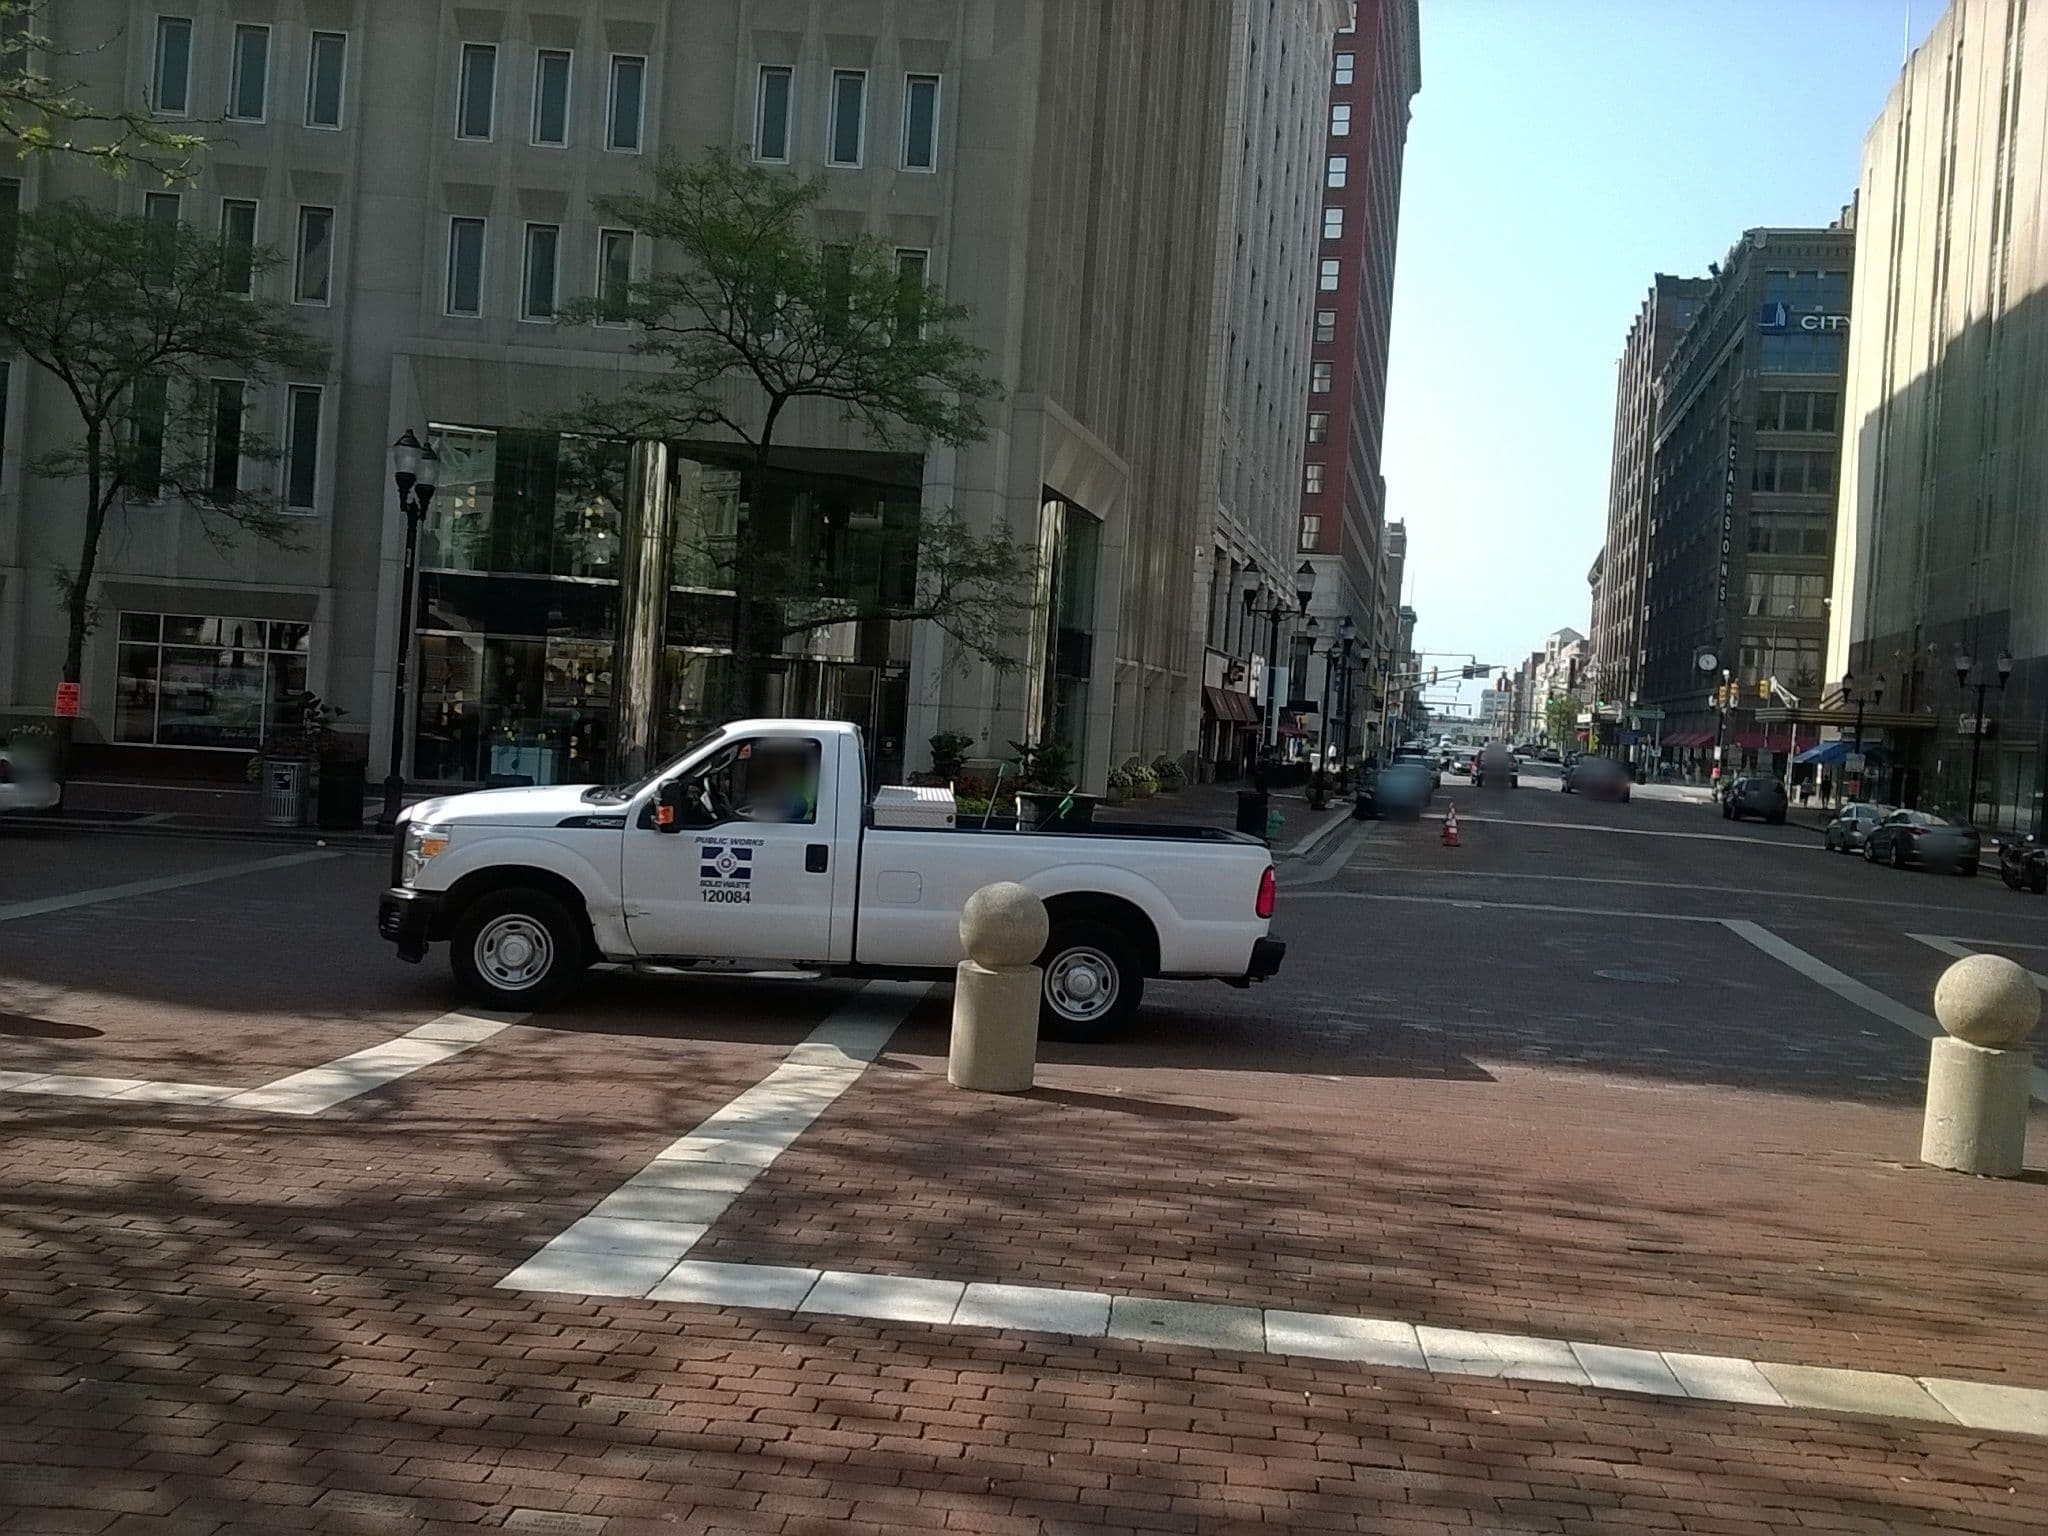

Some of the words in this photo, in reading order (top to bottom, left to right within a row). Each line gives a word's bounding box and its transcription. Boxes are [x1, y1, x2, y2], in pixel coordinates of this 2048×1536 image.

[695, 836, 728, 845] PUBLIC
[730, 838, 765, 847] WORKS
[723, 881, 751, 889] WASTE
[701, 889, 751, 904] 120084
